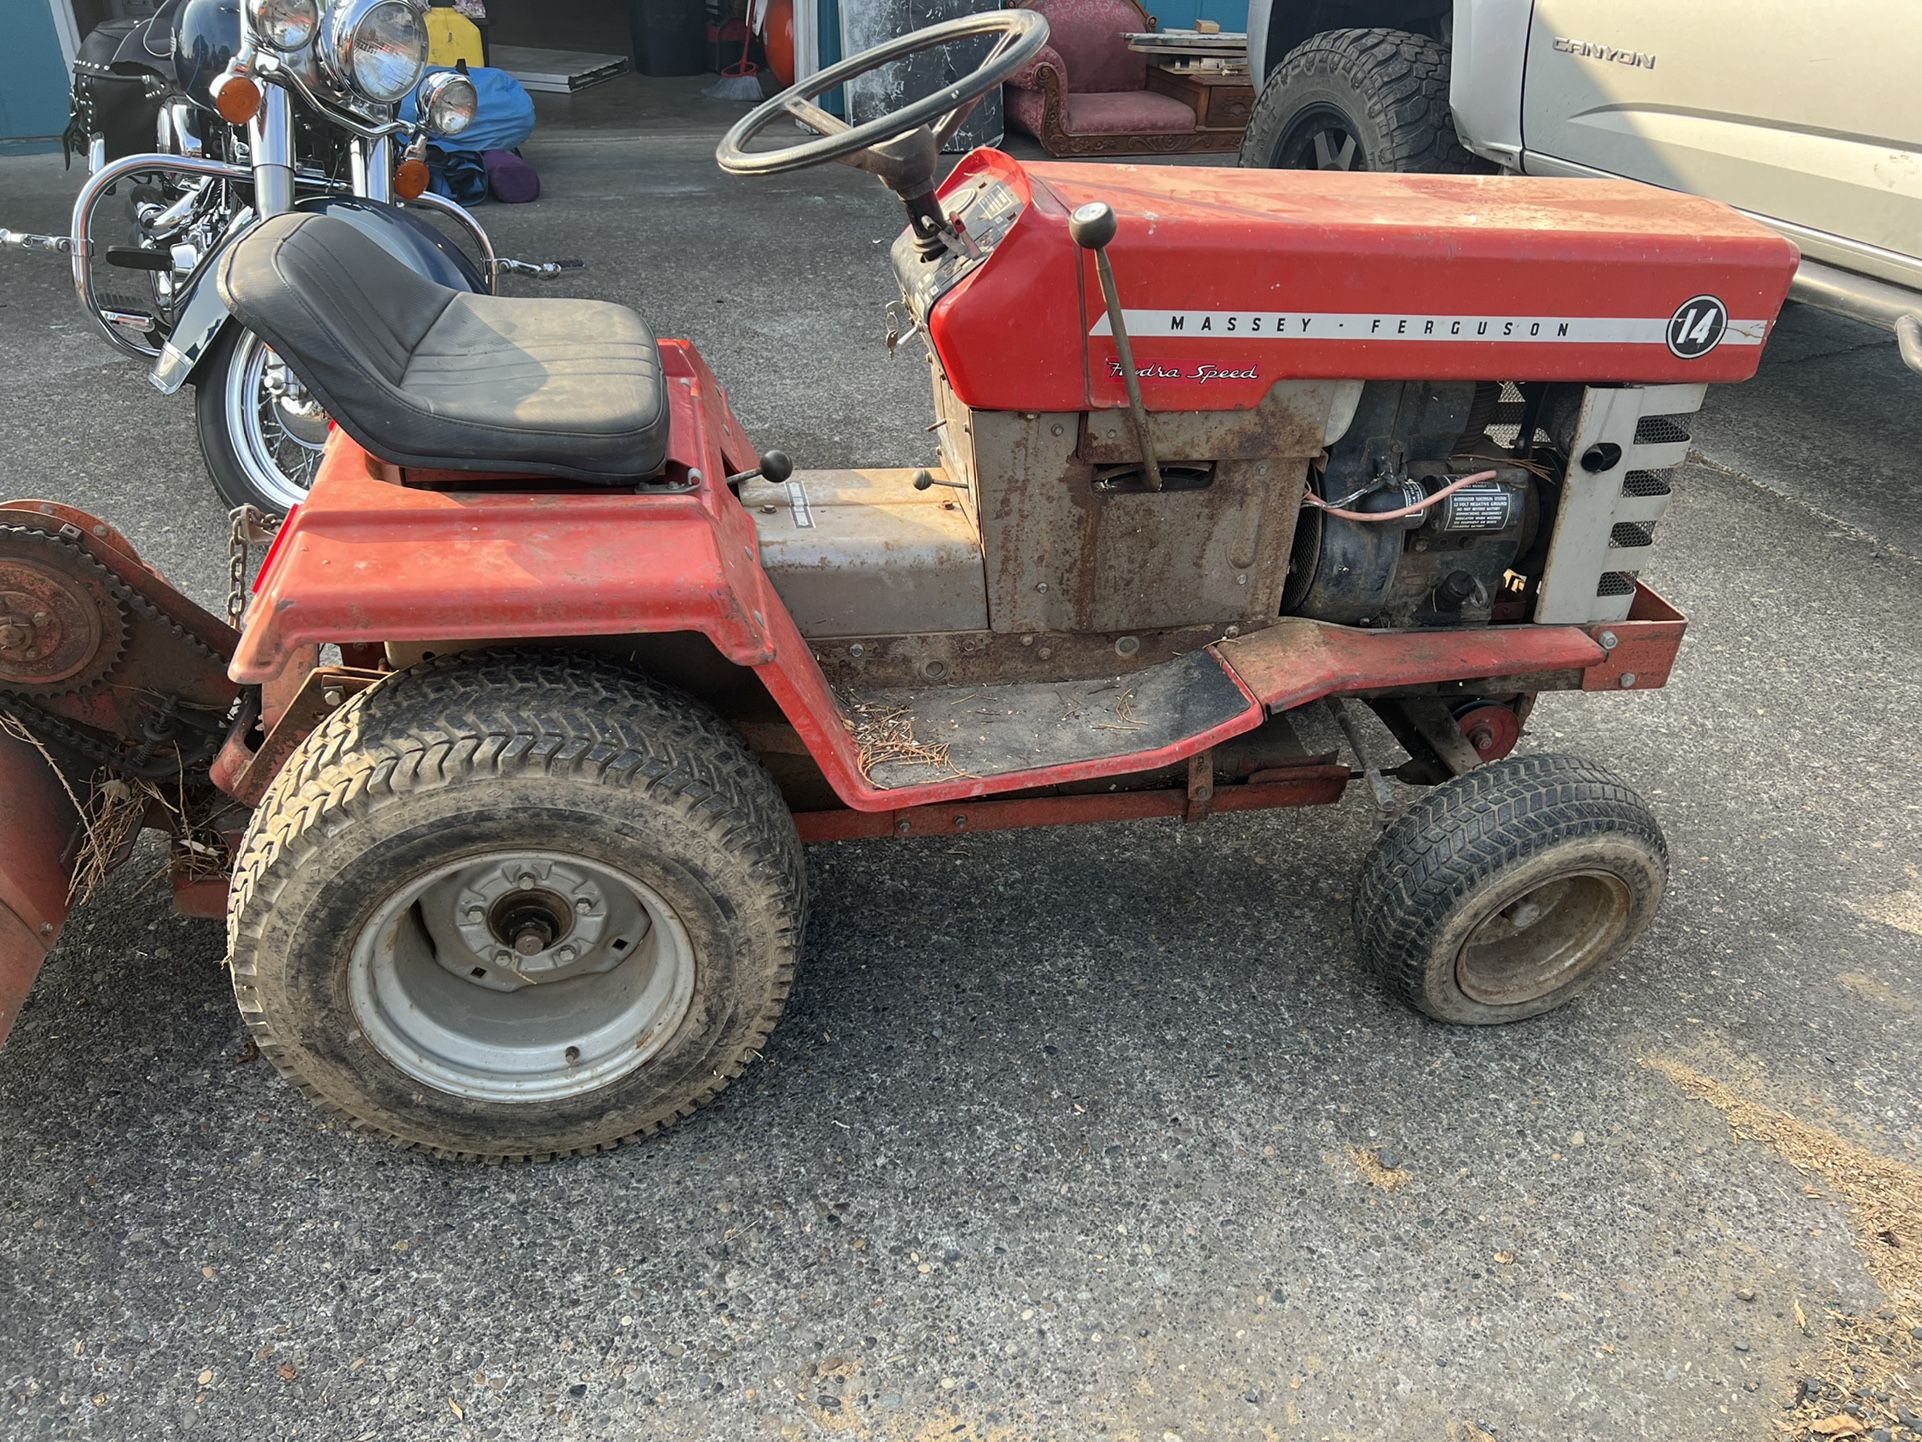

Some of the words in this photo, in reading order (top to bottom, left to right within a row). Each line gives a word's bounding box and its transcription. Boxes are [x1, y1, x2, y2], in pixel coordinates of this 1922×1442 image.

[1552, 36, 1656, 69] CANYON
[1171, 316, 1311, 332] MASSEY
[1371, 319, 1569, 337] FERGUSON
[1676, 308, 1718, 343] 14
[1187, 364, 1258, 384] Speed
